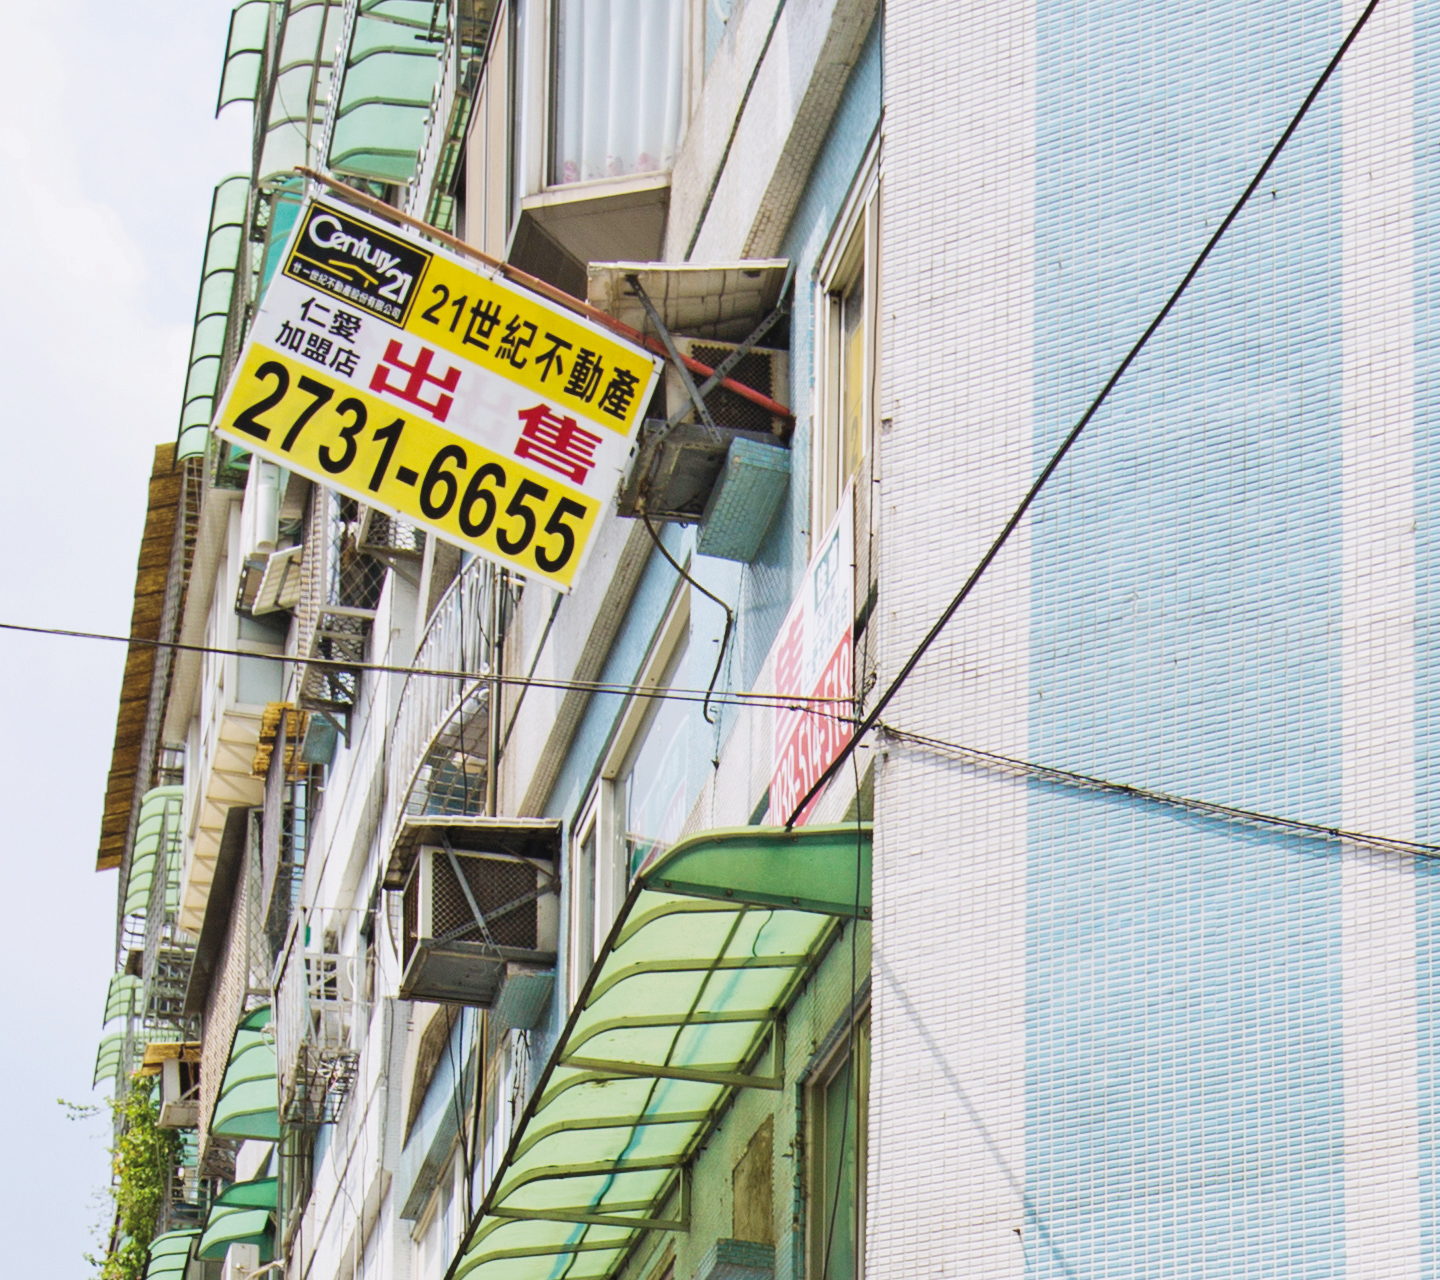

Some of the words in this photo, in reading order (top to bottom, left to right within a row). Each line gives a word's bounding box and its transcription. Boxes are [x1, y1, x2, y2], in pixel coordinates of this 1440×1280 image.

[309, 214, 401, 273] Century
[378, 268, 413, 304] 21
[275, 321, 361, 378] 加盟店
[300, 297, 362, 344] 仁愛
[421, 284, 640, 422] 21世紀不動產
[233, 361, 587, 574] 2731-6655
[369, 339, 603, 486] 出售
